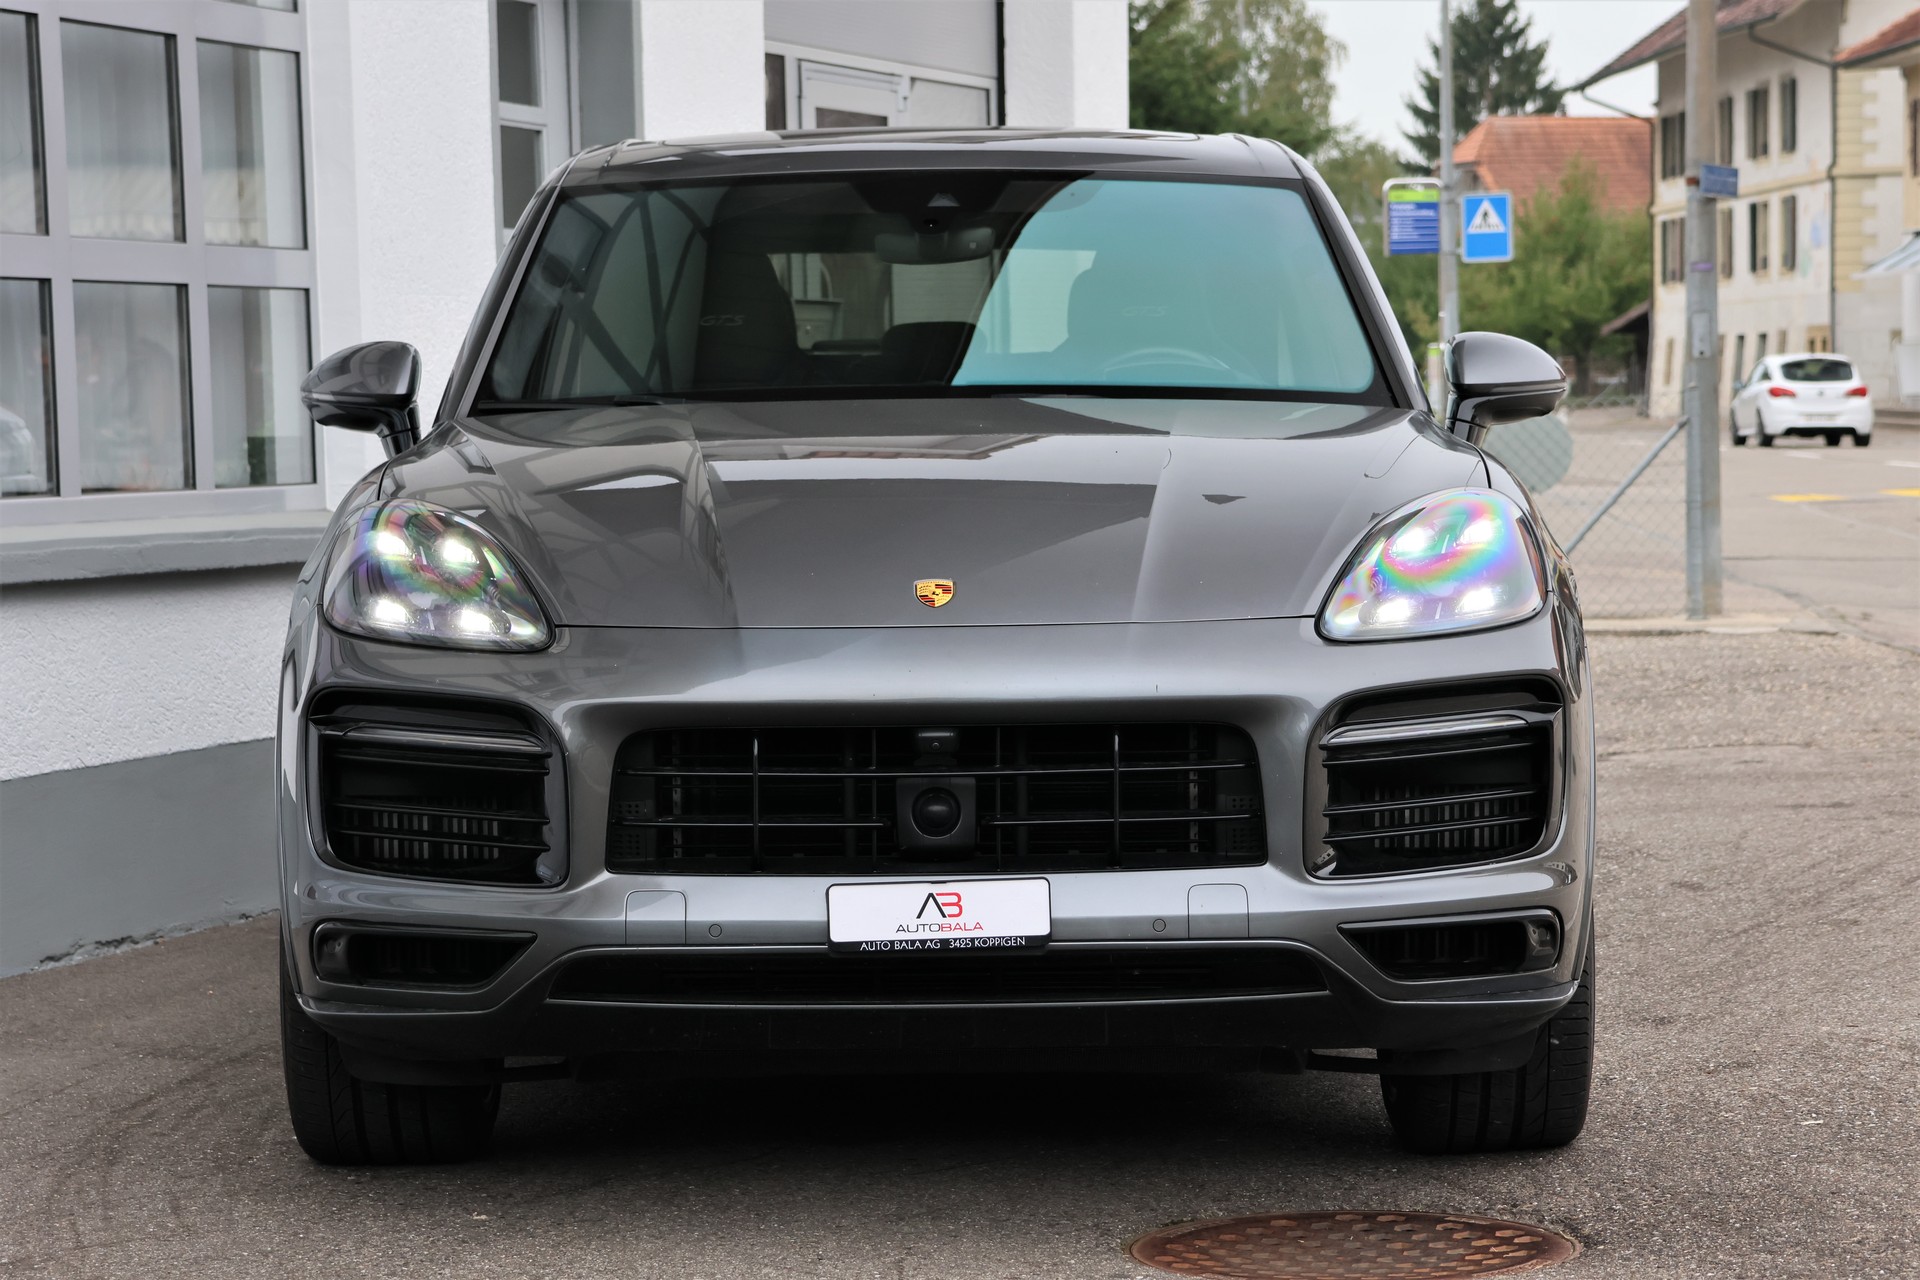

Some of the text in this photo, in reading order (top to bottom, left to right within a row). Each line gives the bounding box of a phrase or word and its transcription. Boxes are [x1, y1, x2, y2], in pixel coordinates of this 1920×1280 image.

[1121, 305, 1168, 317] GTS
[700, 314, 745, 326] GTS
[915, 892, 963, 919] AB
[895, 921, 984, 933] AUTOBALA
[860, 937, 1026, 951] AUTO BALA AG 3425 KOPPIGEN
